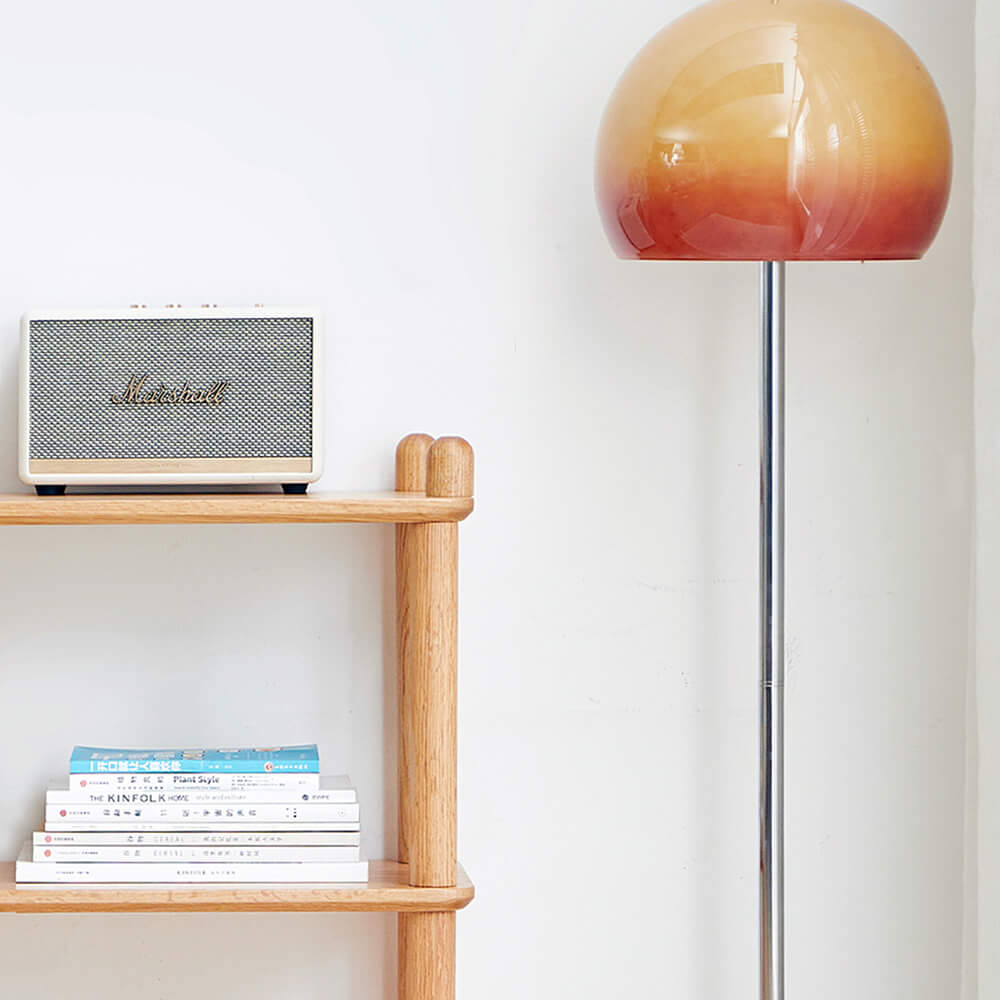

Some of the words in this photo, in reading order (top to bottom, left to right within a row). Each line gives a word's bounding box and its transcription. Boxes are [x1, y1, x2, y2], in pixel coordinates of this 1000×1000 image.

[111, 372, 230, 405] Marshall
[172, 775, 197, 785] Plant
[198, 775, 220, 786] Style
[89, 794, 104, 803] THE
[107, 793, 166, 804] KINFOLK
[167, 794, 189, 803] HOME
